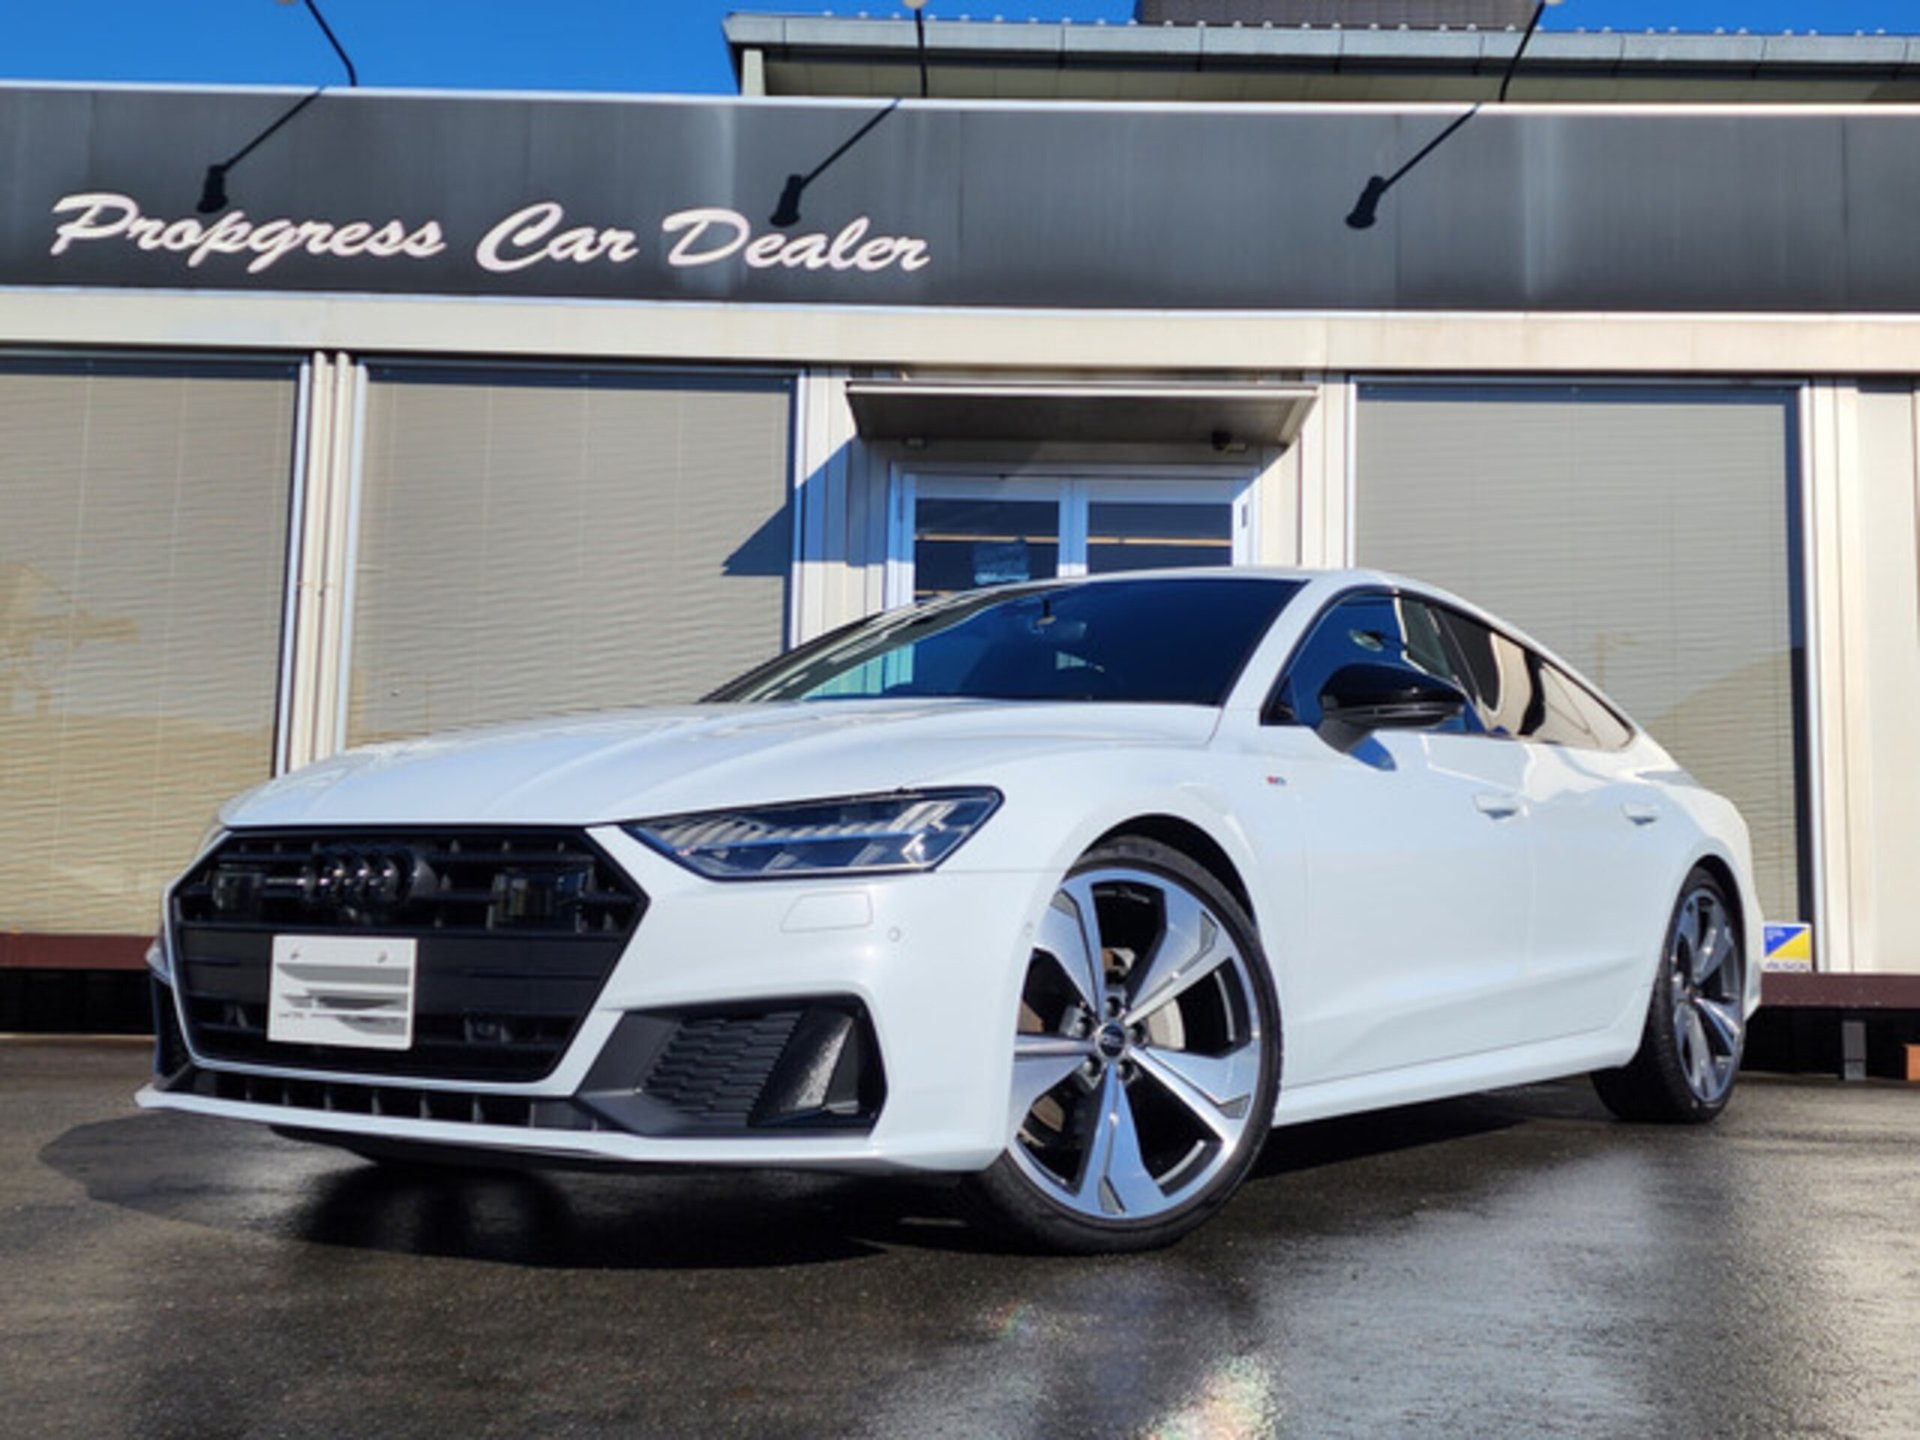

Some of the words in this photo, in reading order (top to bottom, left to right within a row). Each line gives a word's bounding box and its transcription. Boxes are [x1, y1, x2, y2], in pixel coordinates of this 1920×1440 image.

[50, 192, 446, 273] Propgress
[475, 202, 640, 272] Car
[661, 207, 931, 271] Dealer
